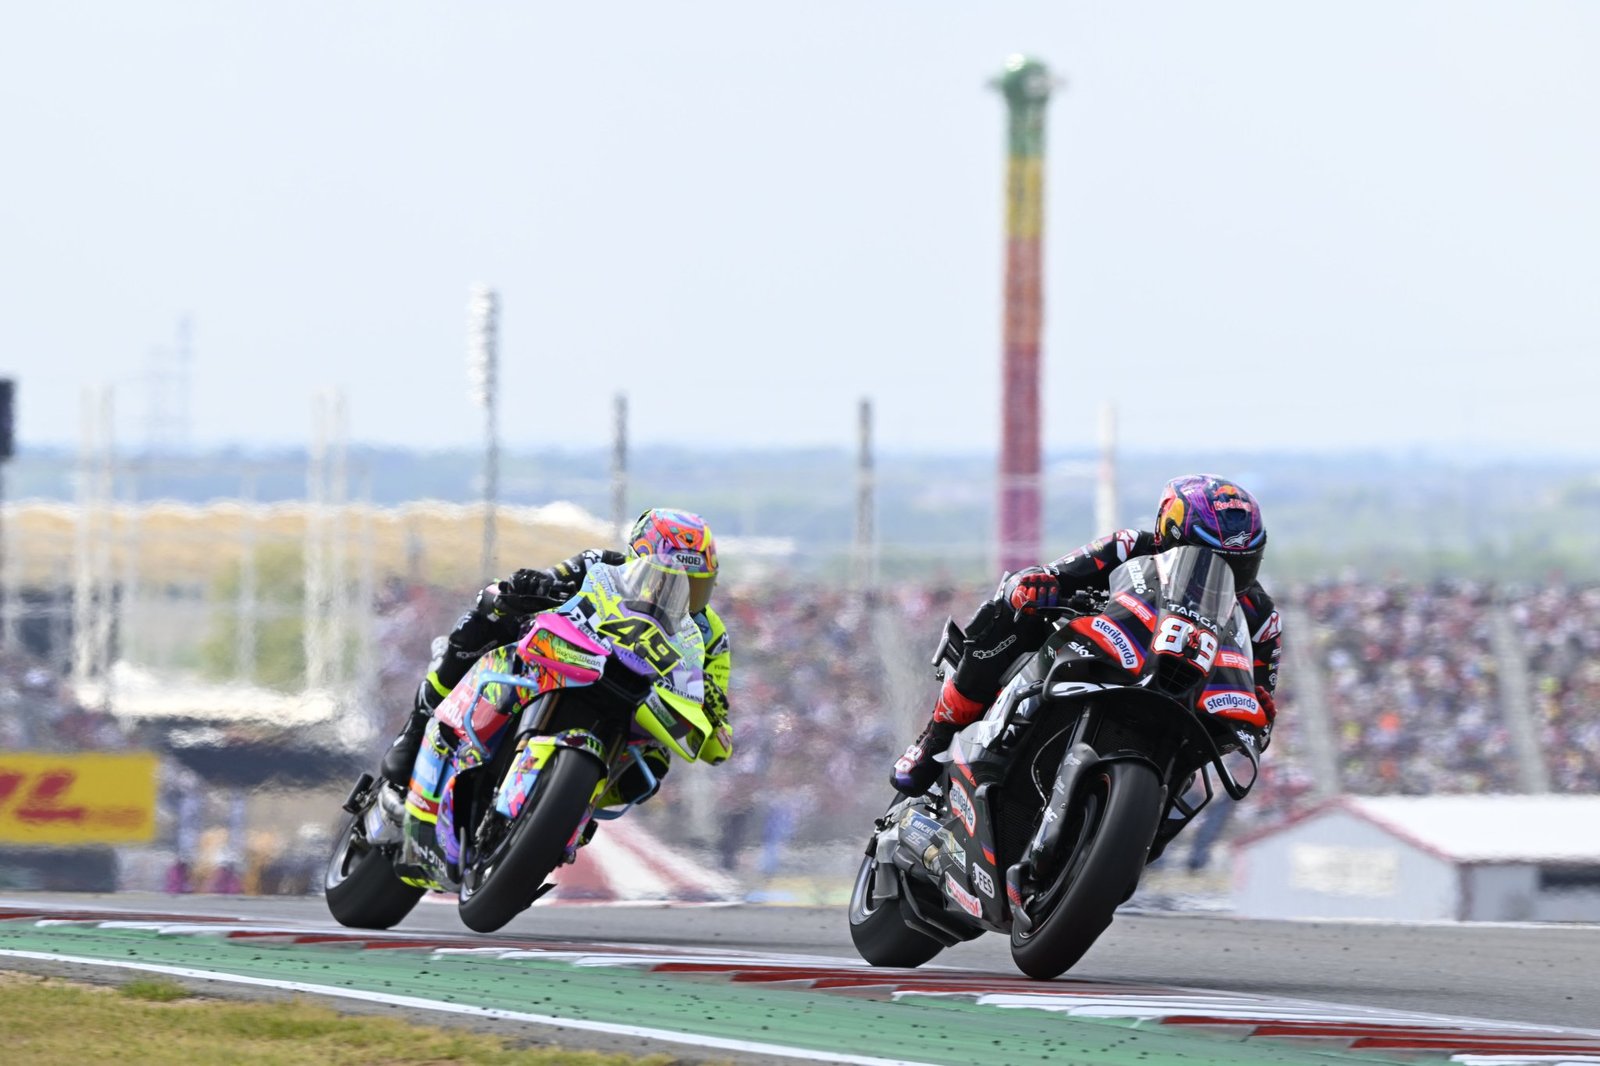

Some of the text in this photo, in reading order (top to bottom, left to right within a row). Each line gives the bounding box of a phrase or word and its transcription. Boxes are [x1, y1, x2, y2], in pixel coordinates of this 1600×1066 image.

[1213, 500, 1238, 511] Red
[675, 554, 701, 566] SHOEI
[1118, 595, 1153, 620] BS
[1168, 603, 1219, 635] TARGA
[598, 616, 682, 676] 49
[1068, 641, 1095, 657] sky
[1094, 620, 1136, 666] sterilgarda
[1152, 615, 1218, 675] 89
[1220, 653, 1250, 668] BS
[1207, 693, 1257, 711] sterilgarda
